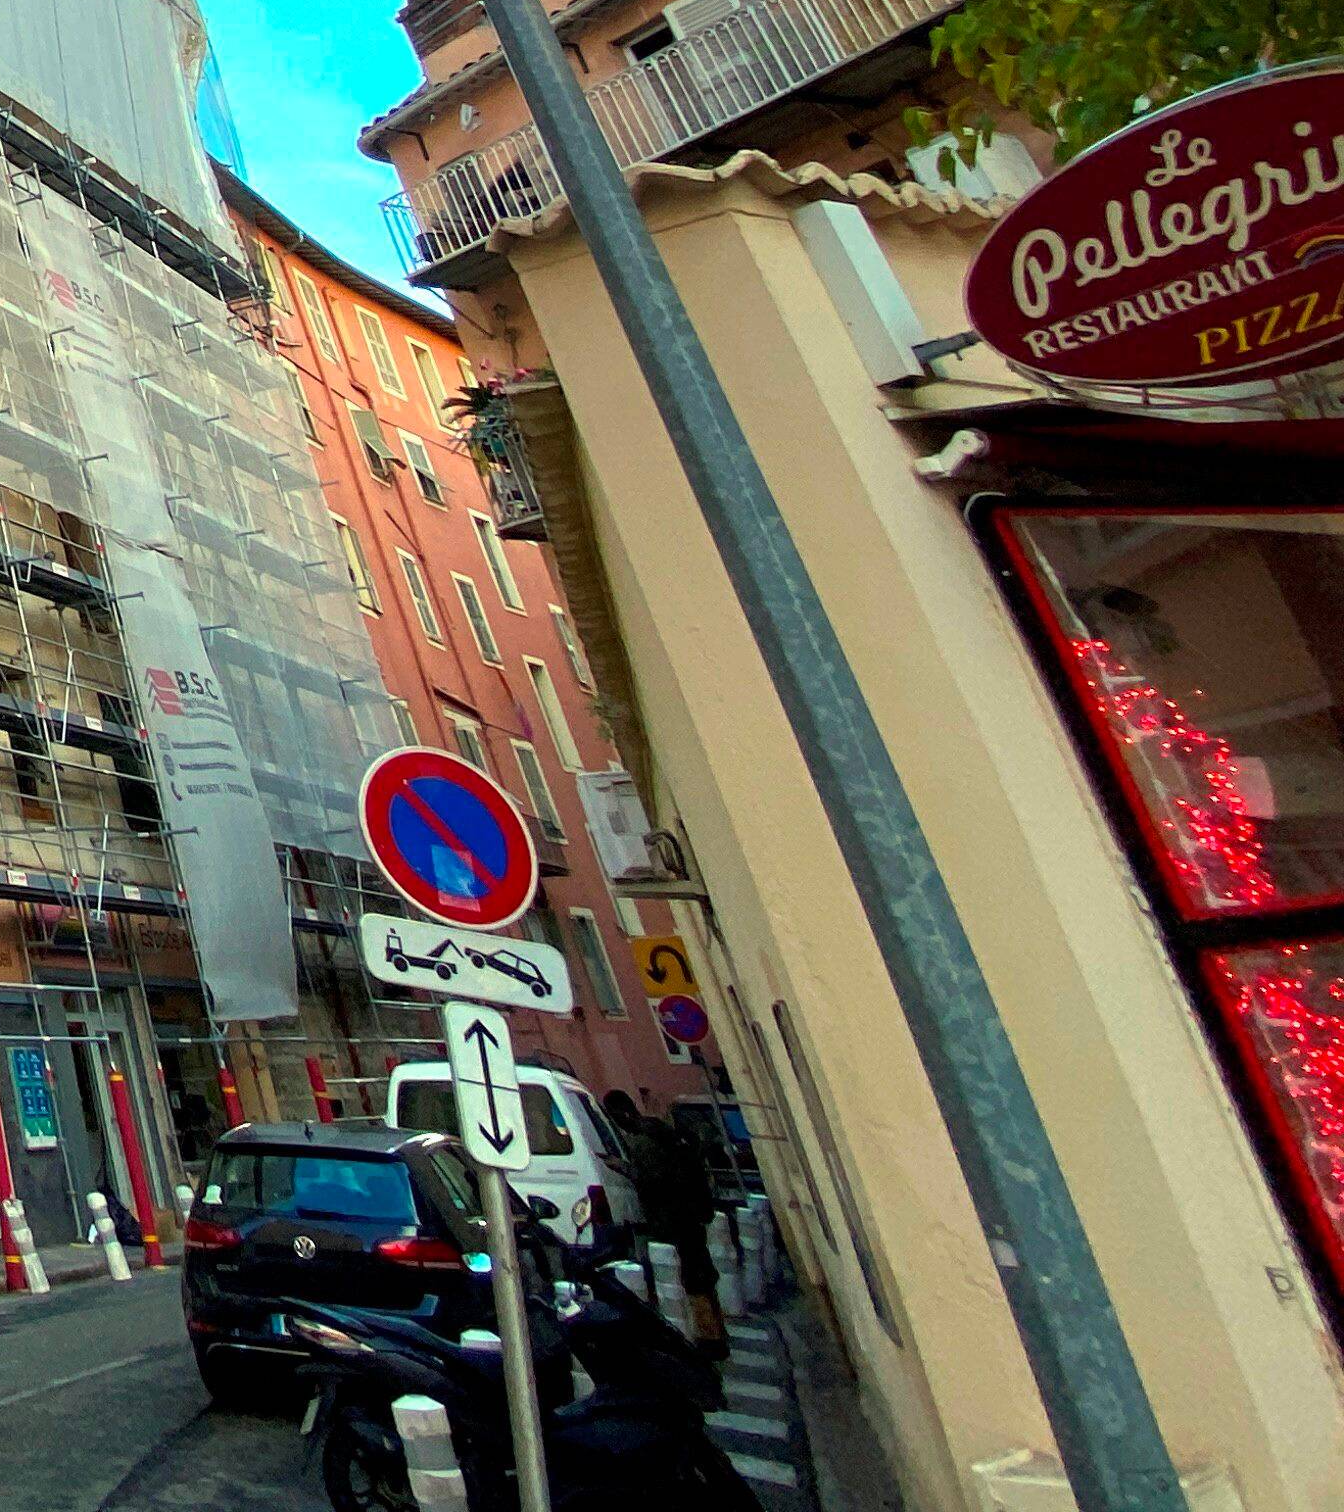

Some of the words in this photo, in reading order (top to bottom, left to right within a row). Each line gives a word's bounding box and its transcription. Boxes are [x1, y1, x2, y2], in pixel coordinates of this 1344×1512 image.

[1145, 128, 1216, 187] Le
[1022, 250, 1276, 359] RESTAURANT
[175, 670, 218, 700] B.S.C
